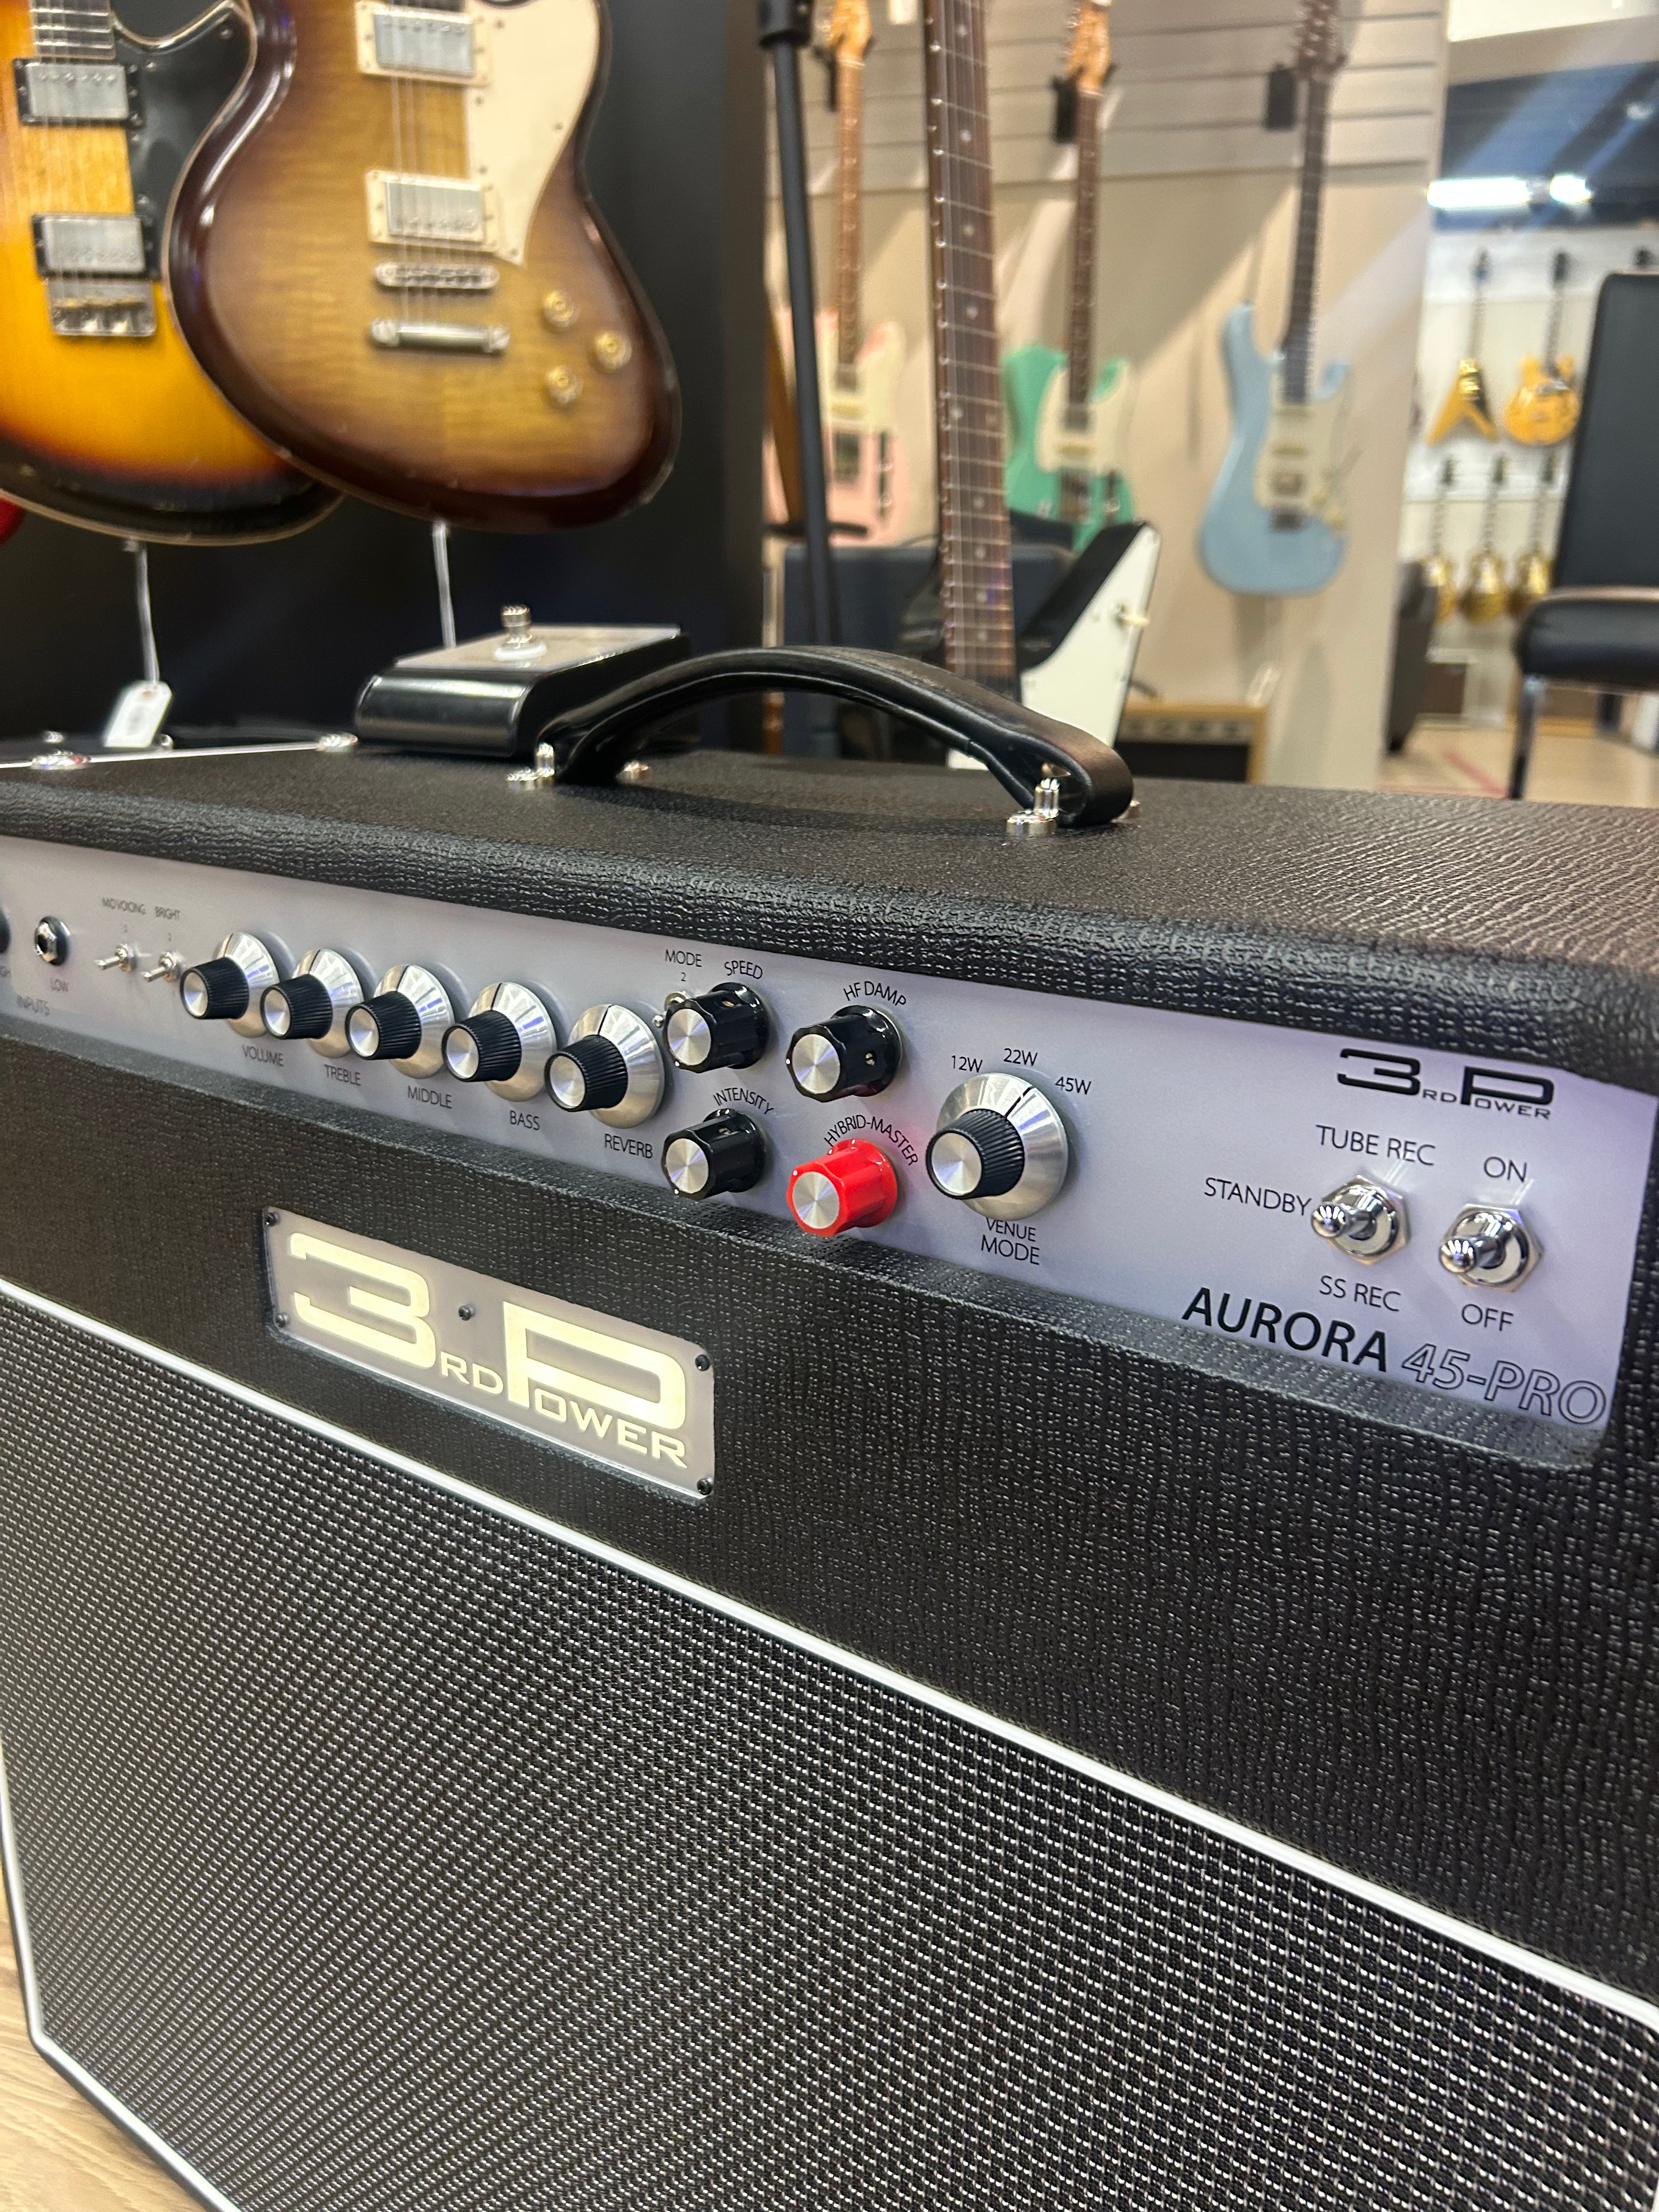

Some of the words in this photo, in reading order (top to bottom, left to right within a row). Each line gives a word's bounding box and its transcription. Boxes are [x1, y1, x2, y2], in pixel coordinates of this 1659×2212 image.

[155, 906, 180, 921] BRIGHT
[665, 949, 702, 967] MODE
[680, 972, 686, 982] 2
[724, 961, 763, 980] SPEED
[50, 978, 68, 992] LOW
[843, 983, 862, 1002] HF
[864, 981, 907, 1007] DAMP
[16, 994, 50, 1016] INPUTS
[242, 1045, 284, 1067] VOLUME
[952, 1055, 983, 1073] 12W
[1003, 1048, 1038, 1066] 22W
[324, 1064, 361, 1087] TREBLE
[1054, 1076, 1092, 1095] 45W
[408, 1085, 452, 1109] MIDDLE
[713, 1087, 774, 1115] INTENSITY
[510, 1110, 540, 1131] BASS
[605, 1133, 653, 1159] REVERB
[823, 1114, 918, 1166] HYBRID-MASTER
[1317, 1125, 1379, 1155] TUBE
[1387, 1138, 1436, 1166] REC
[1483, 1156, 1527, 1182] ON
[1204, 1177, 1312, 1216] STANDBY
[985, 1216, 1037, 1242] VENUE
[981, 1235, 1040, 1265] MODE
[1319, 1276, 1346, 1298] SS
[1354, 1284, 1401, 1312] REC
[1462, 1304, 1514, 1331] OFF
[1182, 1286, 1387, 1373] AURORA
[1402, 1343, 1606, 1425] 45-PRO
